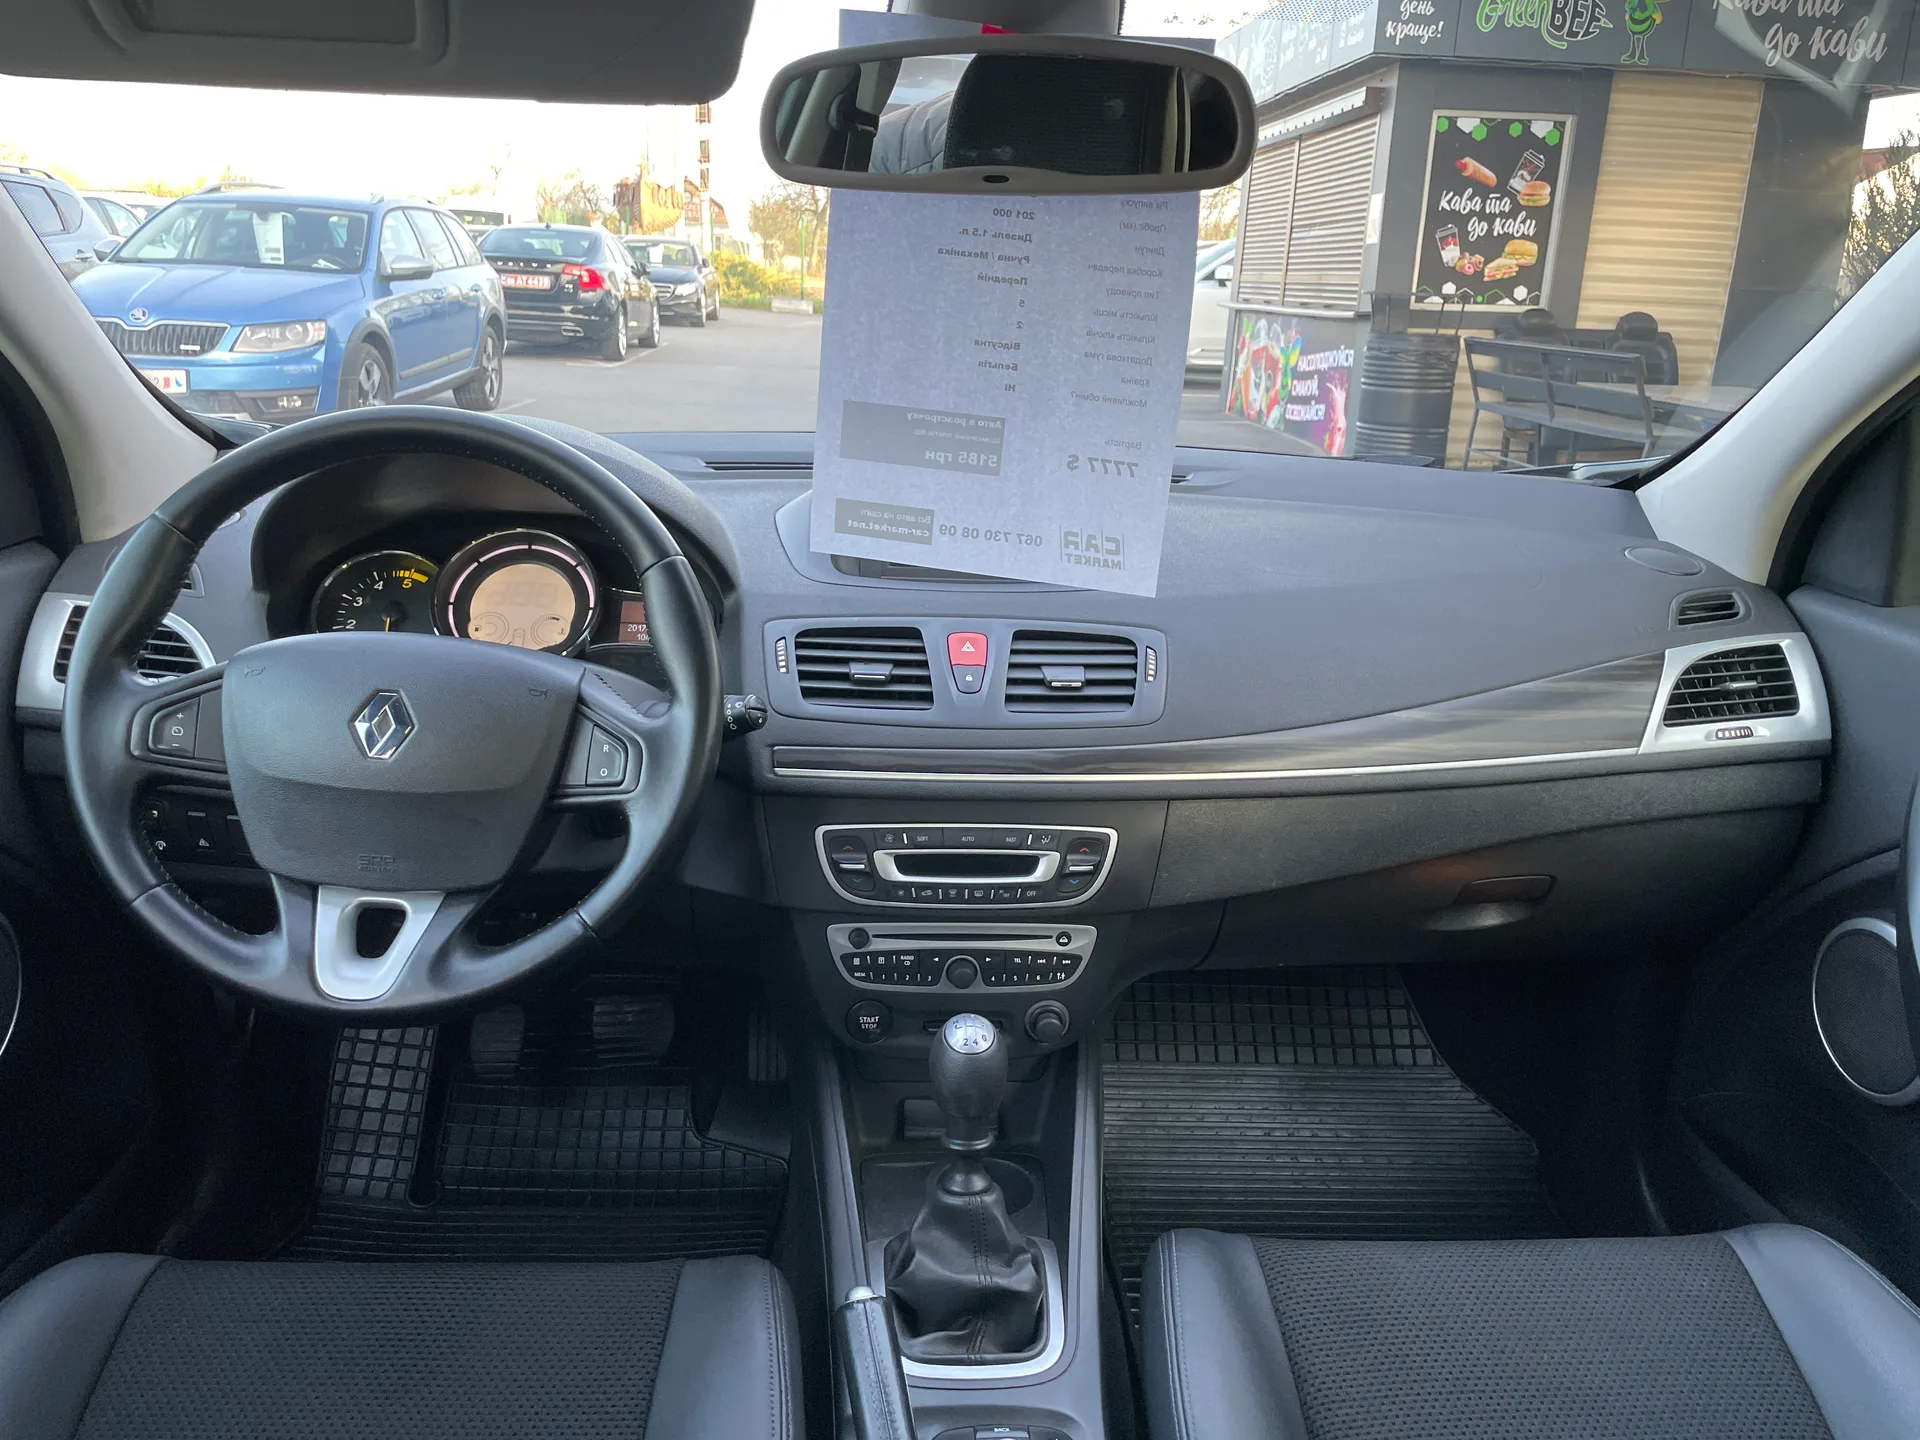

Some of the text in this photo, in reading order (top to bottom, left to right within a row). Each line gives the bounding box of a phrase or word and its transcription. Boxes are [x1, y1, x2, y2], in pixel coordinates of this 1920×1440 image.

[1385, 20, 1444, 46] краще!
[1764, 16, 1888, 67] до кави
[1438, 187, 1512, 214] Кава та
[1468, 211, 1537, 242] до кави
[373, 581, 384, 591] 4
[401, 579, 413, 588] 5
[353, 596, 363, 607] 3
[347, 619, 356, 630] 2
[603, 744, 609, 753] R
[963, 1037, 969, 1047] 2
[972, 1038, 979, 1047] 4
